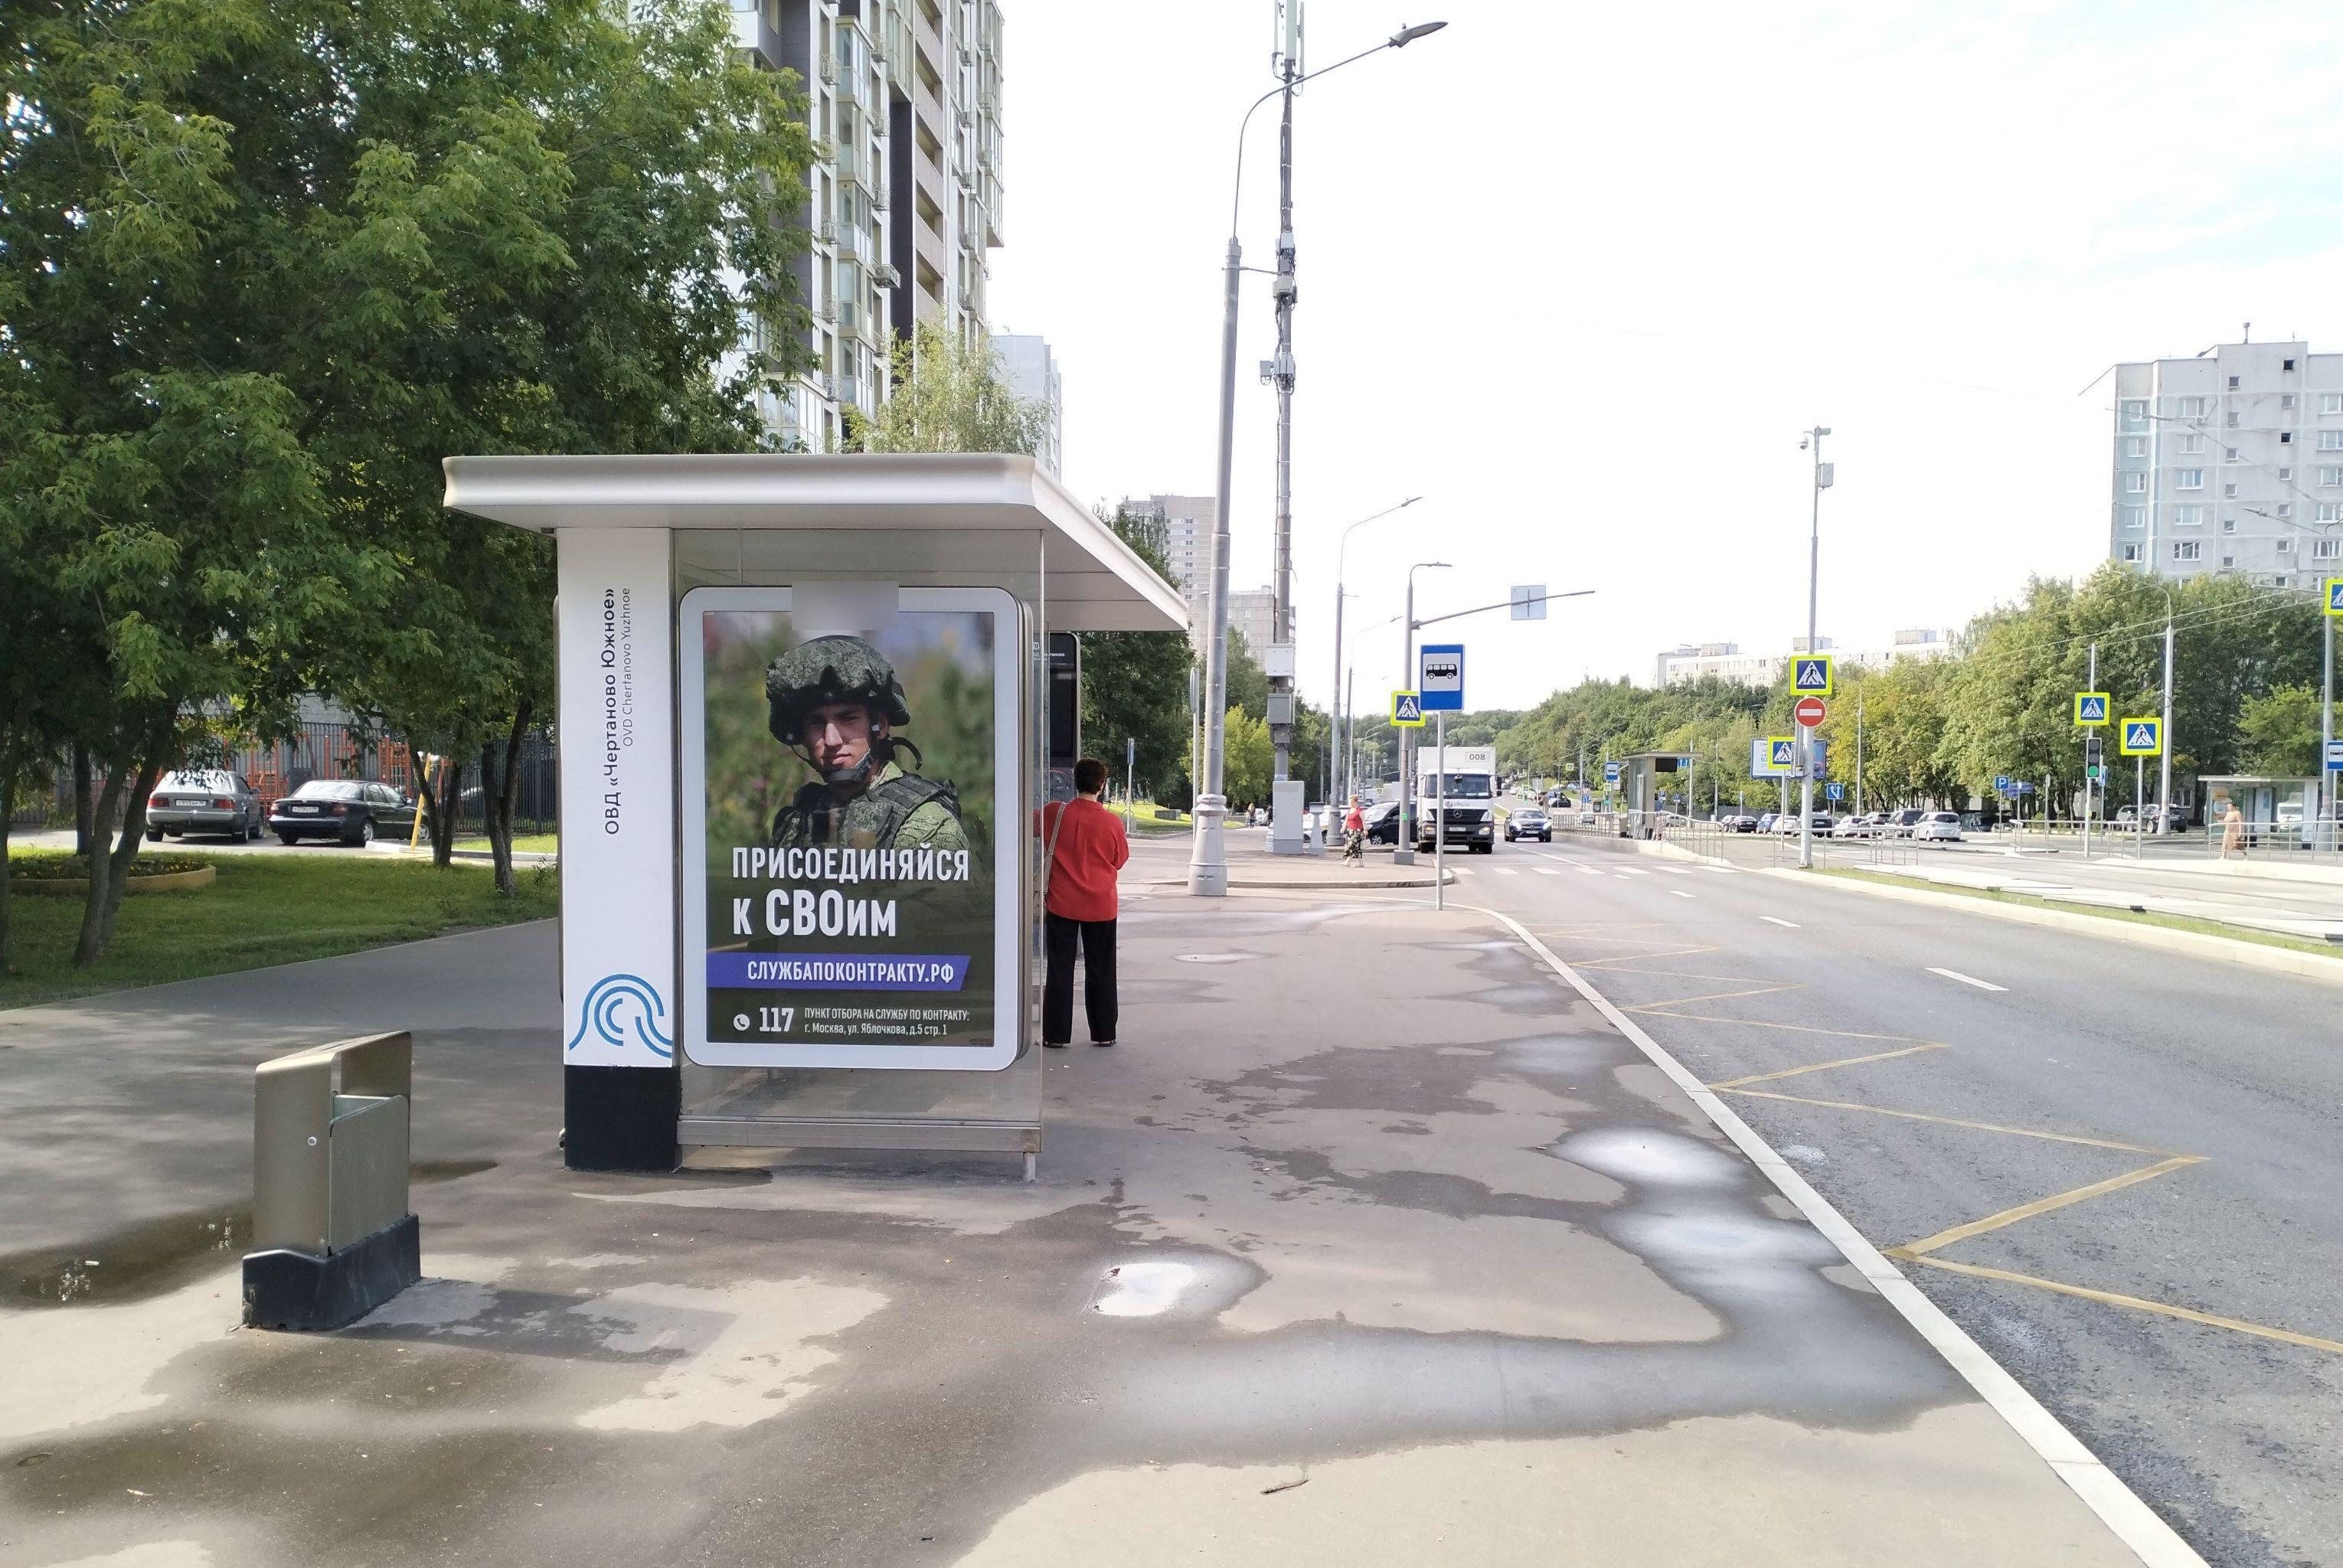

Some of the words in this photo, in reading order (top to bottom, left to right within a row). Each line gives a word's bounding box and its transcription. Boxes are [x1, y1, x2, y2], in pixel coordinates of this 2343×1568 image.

[600, 588, 616, 668] Южное»
[620, 587, 631, 640] Yuzhnoe
[622, 643, 632, 715] Chertanovo
[603, 675, 621, 786] «Чертаново
[623, 718, 633, 746] OVD
[1998, 777, 2007, 789] P
[604, 792, 621, 835] ОВД
[732, 842, 969, 884] ПРИСОЕДИНЯЙСЯ
[747, 961, 954, 983] СЛУЖБАПОКОНТРАКТУ.РФ
[759, 1007, 794, 1032] 117
[804, 1024, 811, 1033] г.
[812, 1022, 846, 1035] Москва,
[847, 1024, 859, 1035] ул.
[861, 1023, 909, 1035] Яблочкова,
[923, 1025, 941, 1037] стр.
[942, 1024, 947, 1035] 1
[805, 1008, 831, 1019] ПУНКТ
[832, 1008, 863, 1019] ОТБОРА
[863, 1008, 874, 1019] НА
[875, 1008, 908, 1020] СЛУЖБУ
[909, 1009, 921, 1020] ПО
[923, 1009, 970, 1021] КОНТРАКТУ:
